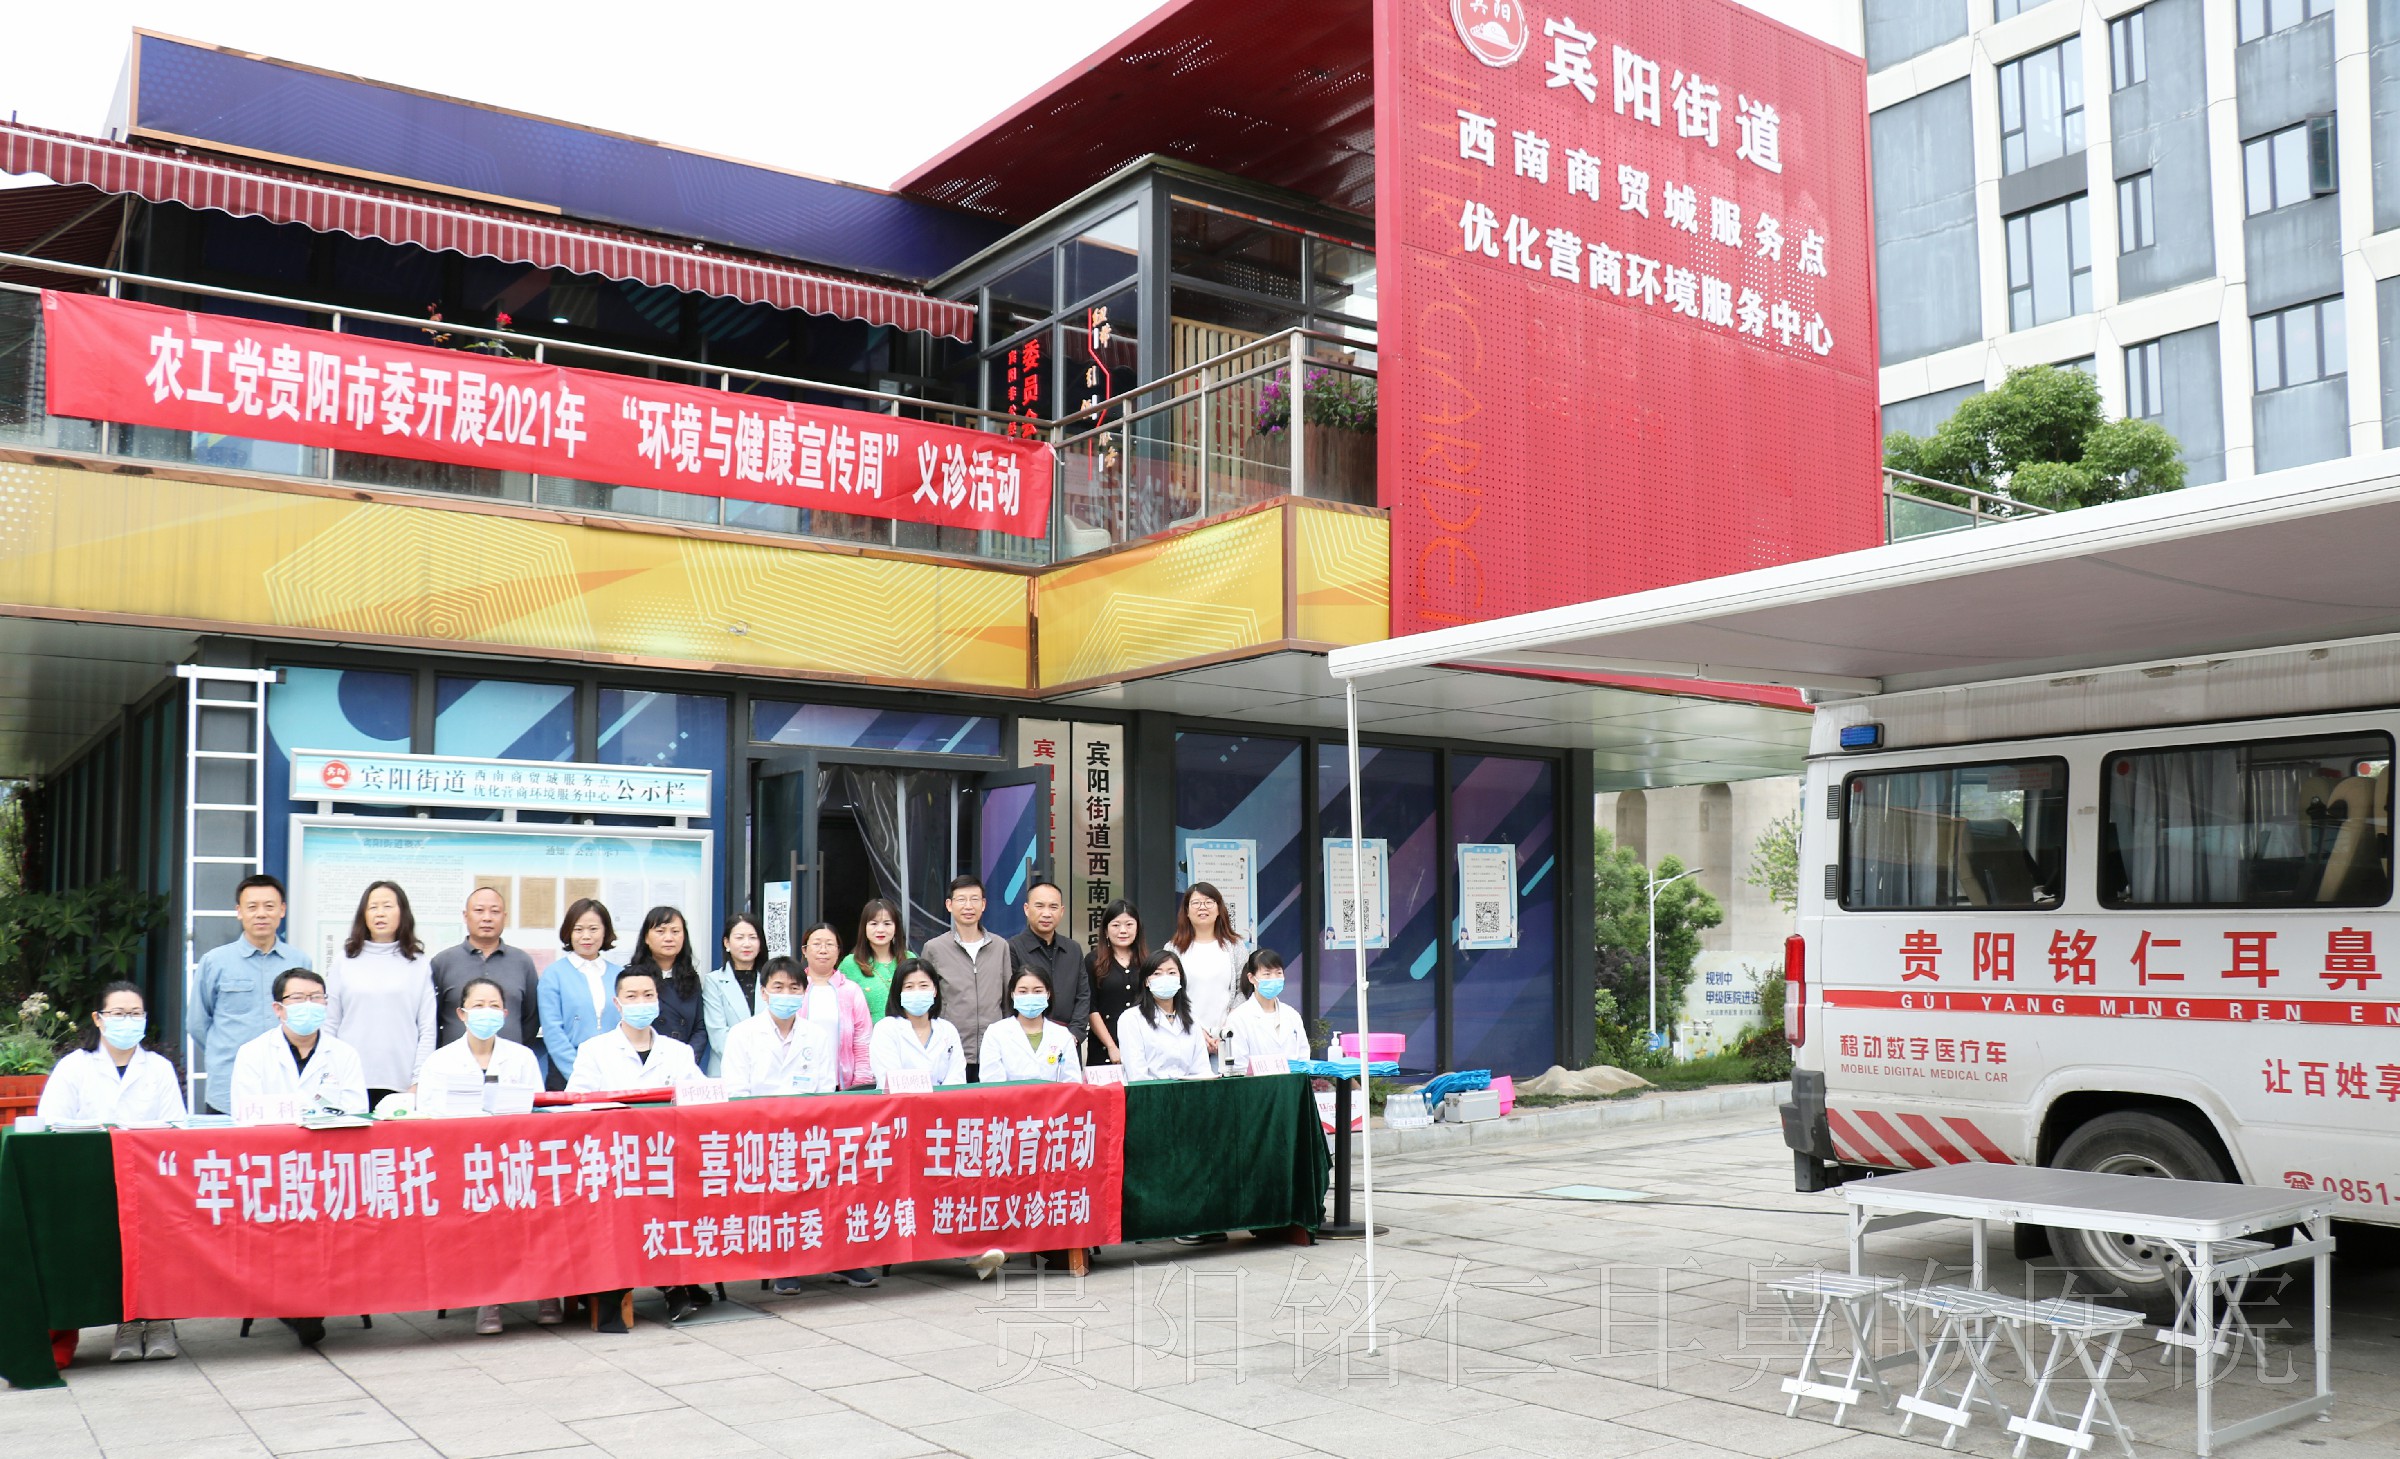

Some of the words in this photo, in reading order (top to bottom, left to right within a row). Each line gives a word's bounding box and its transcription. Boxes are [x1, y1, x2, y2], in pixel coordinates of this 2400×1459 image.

[1542, 16, 1783, 175] 宾阳街道
[1456, 108, 1828, 278] 西南商贸城服务点
[1458, 199, 1834, 357] 优化营商环境服务中心
[144, 326, 588, 460] 农工党贵阳市委开展2021年
[622, 395, 900, 500] “环境与健康宣传周”
[911, 438, 1020, 517] 义诊活动
[360, 765, 466, 794] 宾阳街道
[474, 769, 611, 788] 西南商贸城服务点
[616, 778, 687, 804] 公示栏
[1899, 926, 2383, 991] 贵阳铭仁耳鼻
[1982, 996, 2065, 1014] YANG
[2100, 1000, 2190, 1017] MING
[2229, 1002, 2301, 1021] REN
[1839, 1034, 2008, 1065] 移动数字医疗车
[1841, 1063, 1880, 1076] MOBILE
[1884, 1065, 1926, 1079] DIGITAL
[1930, 1068, 1981, 1082] MEDICAL
[1985, 1070, 2009, 1084] CAR
[157, 1146, 439, 1226] “牢记殷切嘱托
[462, 1130, 676, 1215] 忠诚干净担当
[698, 1115, 908, 1199] 喜迎建党百年”
[923, 1109, 1097, 1179] 主题教育活动
[642, 1208, 824, 1261] 农工党贵阳市委
[845, 1197, 917, 1245] 进乡镇
[932, 1186, 1091, 1236] 进社区义诊活动
